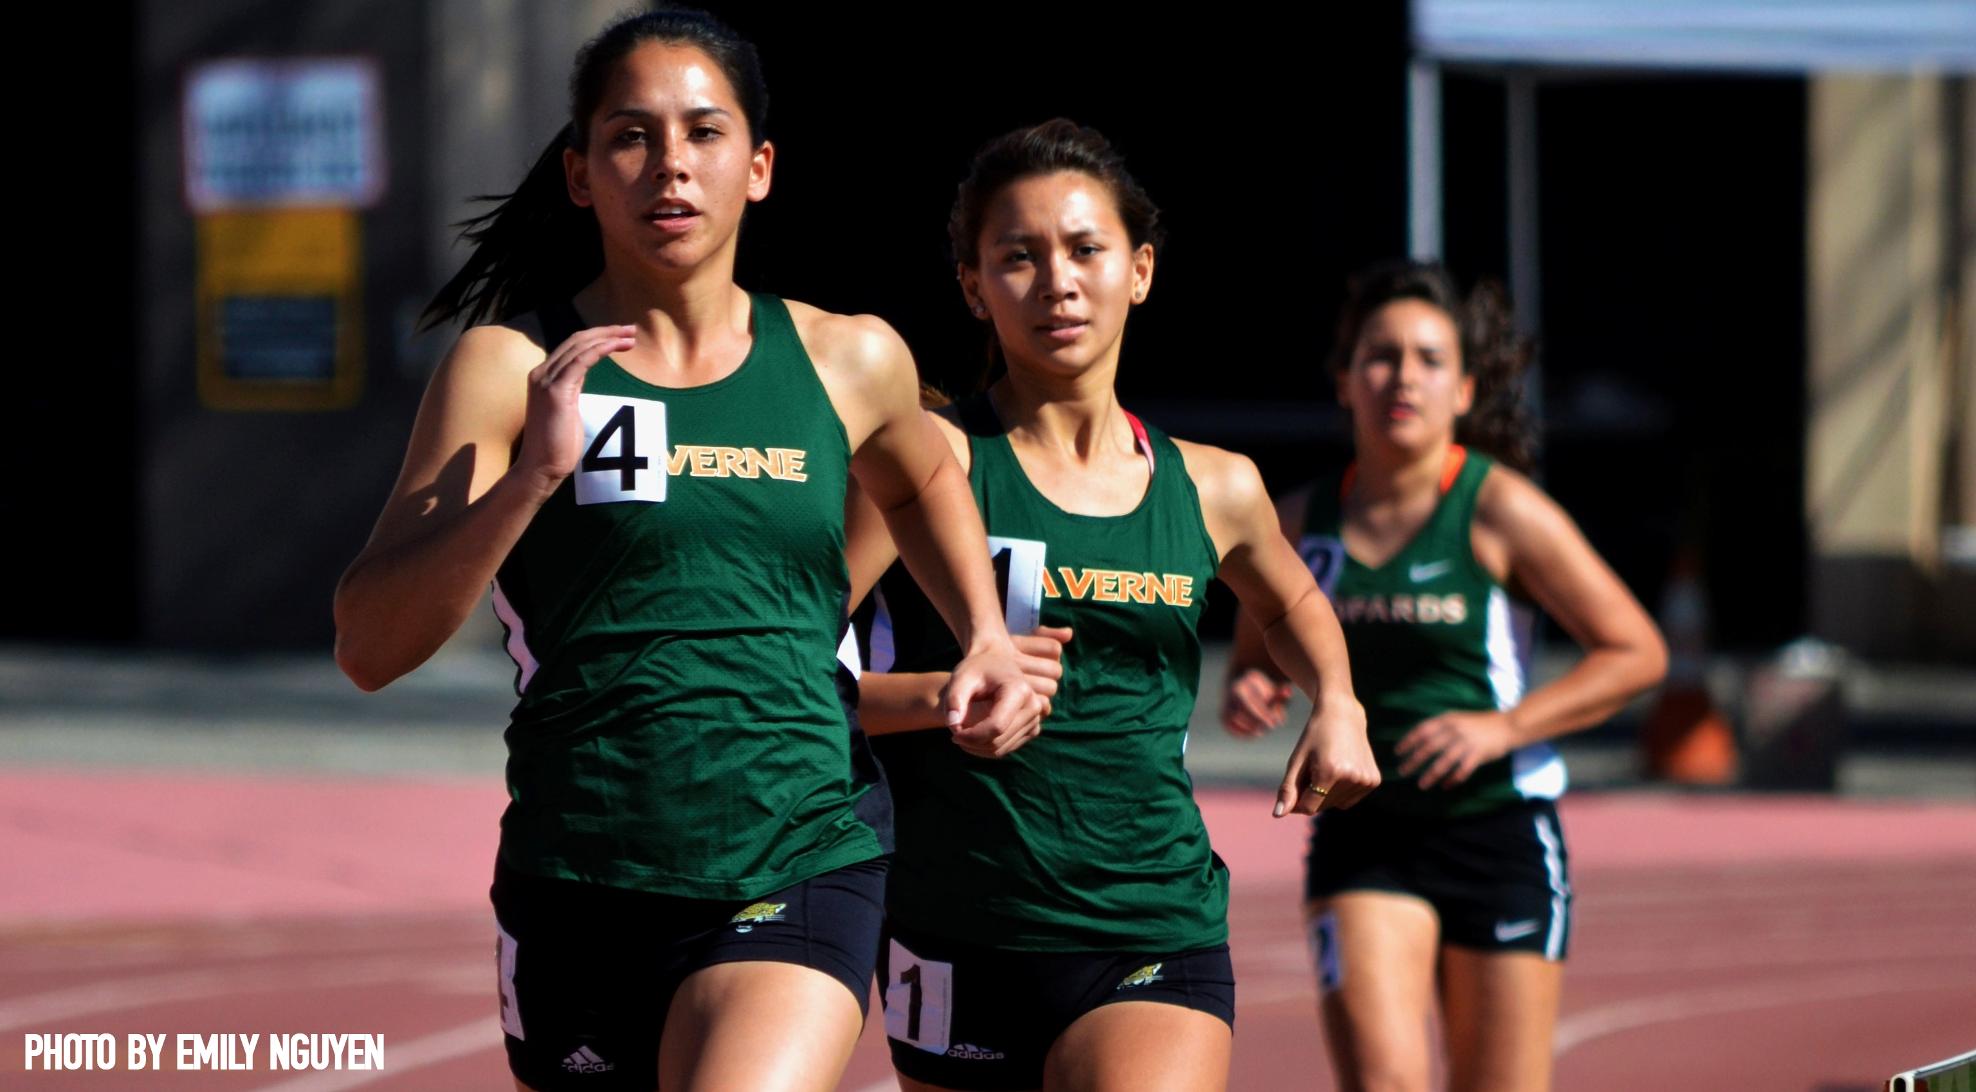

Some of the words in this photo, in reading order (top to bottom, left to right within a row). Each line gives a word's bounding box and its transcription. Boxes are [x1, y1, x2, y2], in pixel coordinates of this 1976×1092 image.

[582, 405, 648, 491] 4
[666, 445, 808, 483] VERNE
[900, 964, 922, 1041] 1
[947, 1047, 1005, 1060] adidas
